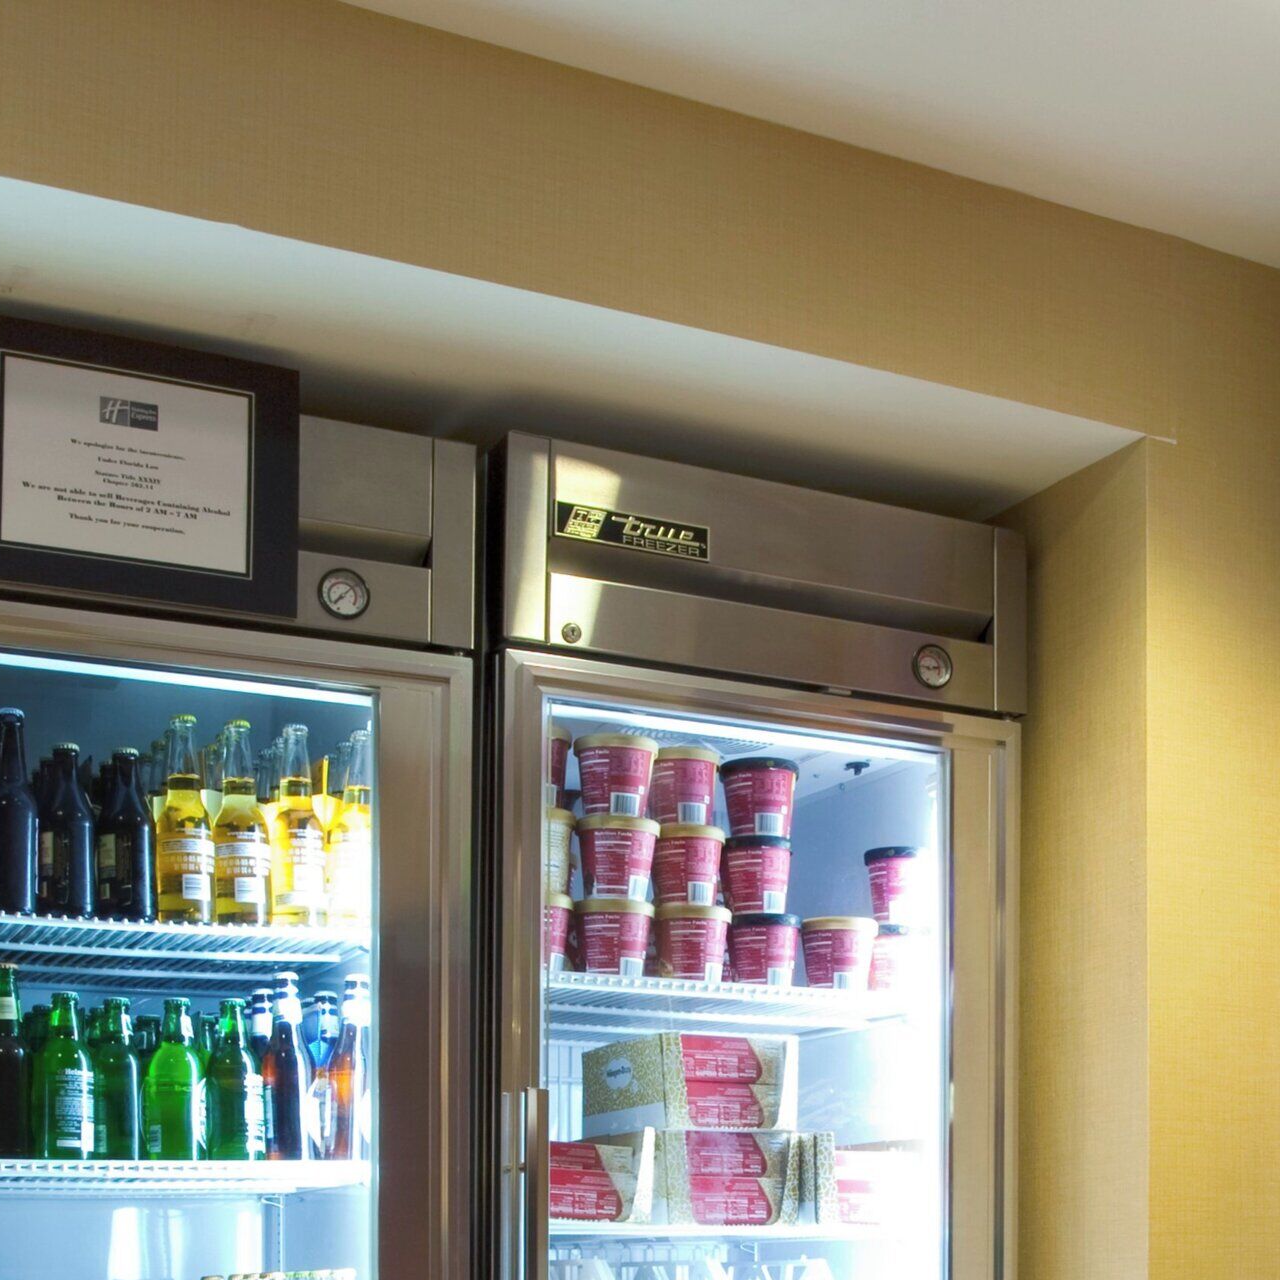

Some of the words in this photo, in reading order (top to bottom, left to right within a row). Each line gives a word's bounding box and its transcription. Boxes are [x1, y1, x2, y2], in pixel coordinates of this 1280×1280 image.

[22, 480, 36, 489] We
[70, 488, 86, 496] able
[115, 494, 156, 507] Beverages
[156, 500, 200, 514] Containing
[202, 506, 231, 517] Alcohol
[57, 494, 92, 505] Between
[109, 501, 134, 512] Hours
[69, 513, 94, 522] Thank
[622, 535, 701, 557] FREEZER
